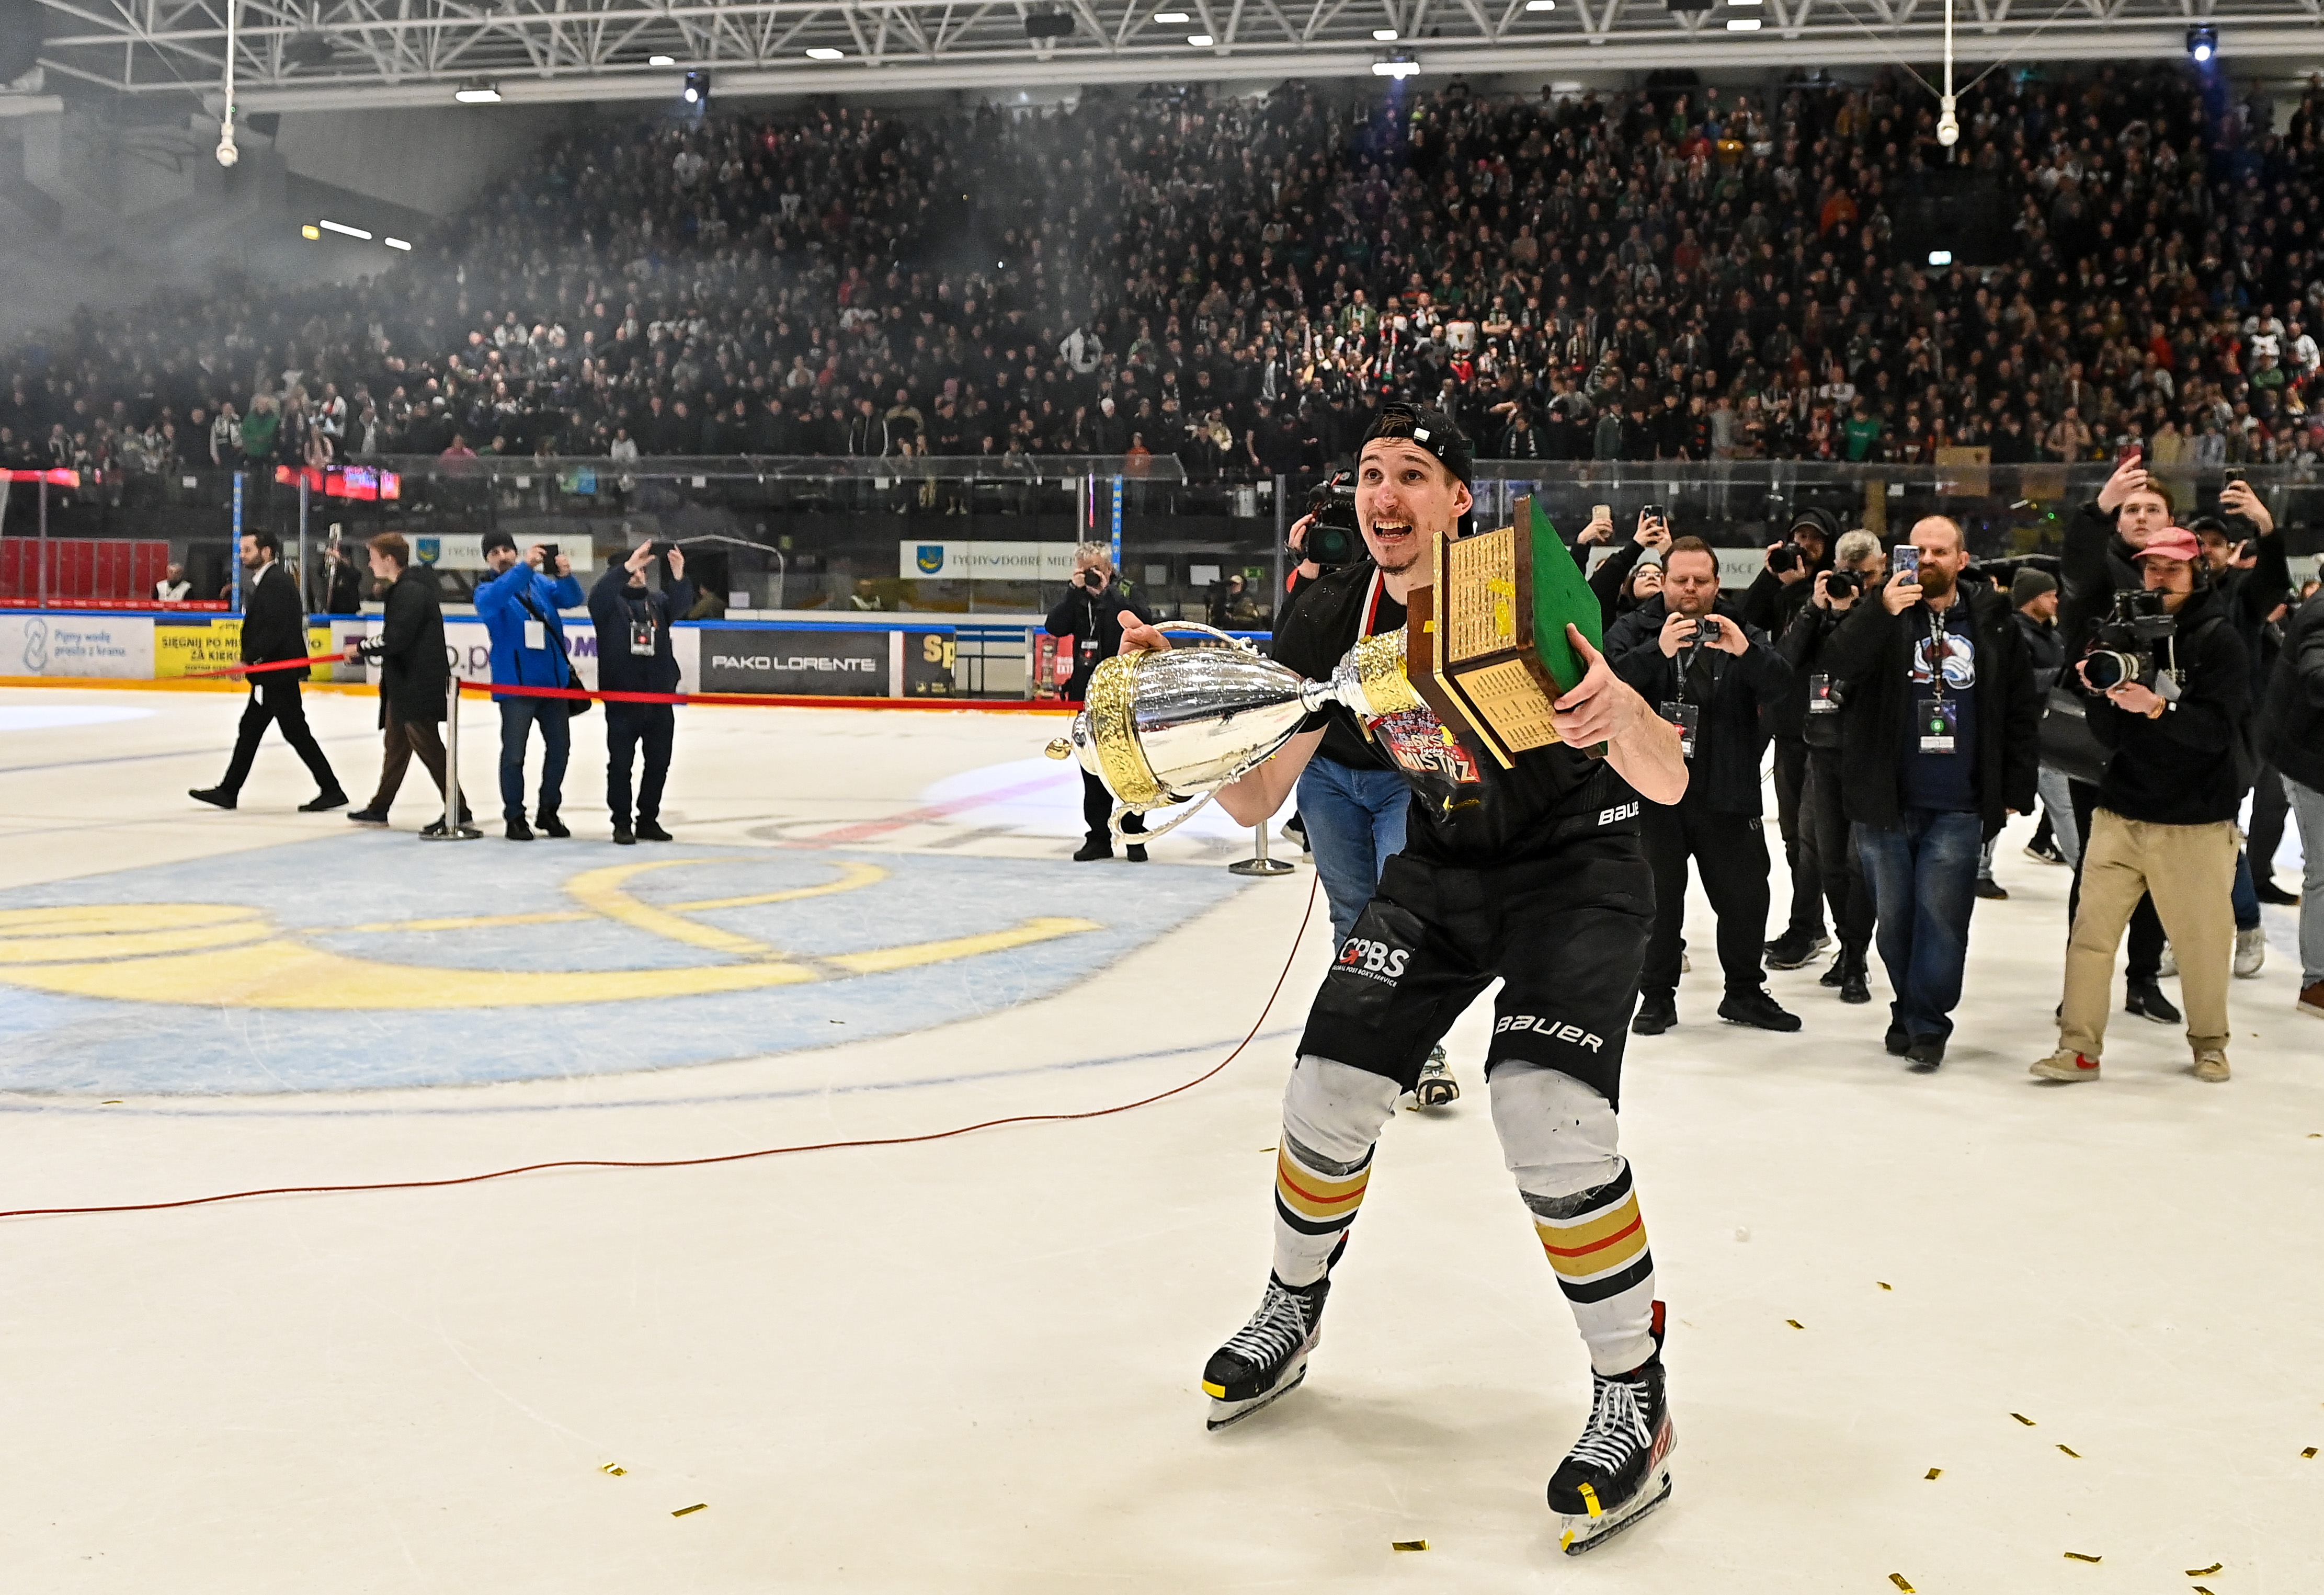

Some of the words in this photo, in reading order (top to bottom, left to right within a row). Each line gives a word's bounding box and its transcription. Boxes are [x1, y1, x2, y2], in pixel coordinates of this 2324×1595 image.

[712, 655, 771, 670] PAKO
[773, 656, 876, 672] LORENTE
[1410, 734, 1443, 747] GKS
[1417, 746, 1444, 756] Tychy
[1397, 749, 1476, 781] MISTRZ
[1373, 974, 1398, 987] SERVICE
